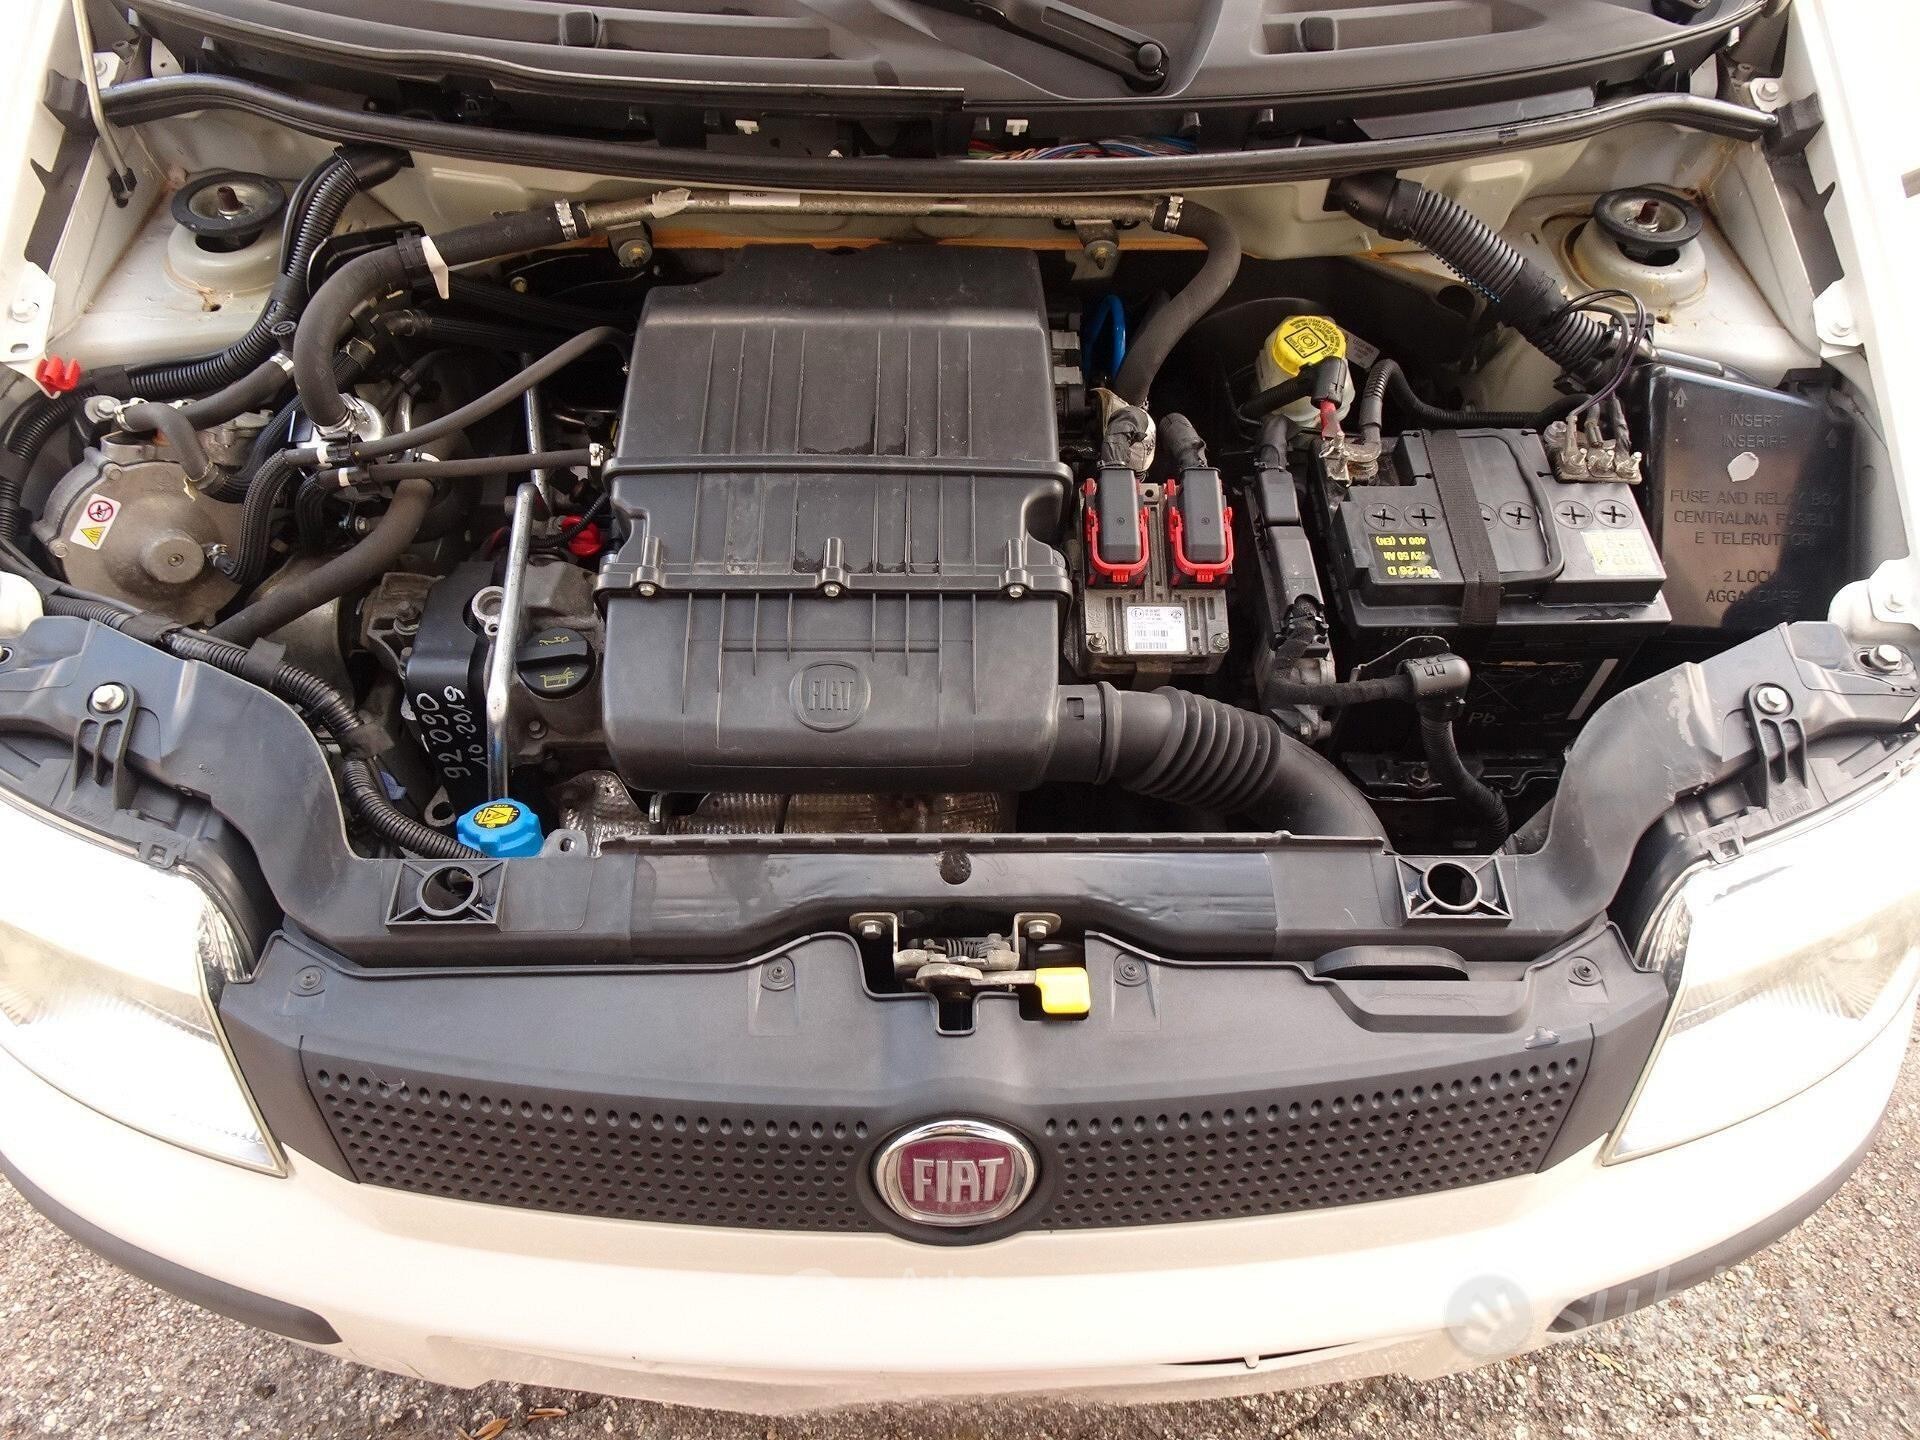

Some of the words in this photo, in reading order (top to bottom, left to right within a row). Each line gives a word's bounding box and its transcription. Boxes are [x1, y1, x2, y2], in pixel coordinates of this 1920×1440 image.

[1729, 413, 1783, 428] INSERT
[1670, 489, 1710, 503] FUSE
[1716, 490, 1749, 505] AND
[1673, 510, 1769, 526] CENTRALINA
[1399, 537, 1407, 546] A
[1409, 537, 1427, 546] 400
[1694, 531, 1705, 545] E
[1722, 570, 1733, 583] 2
[808, 679, 855, 711] FIAT
[913, 1158, 1005, 1203] FIAT
